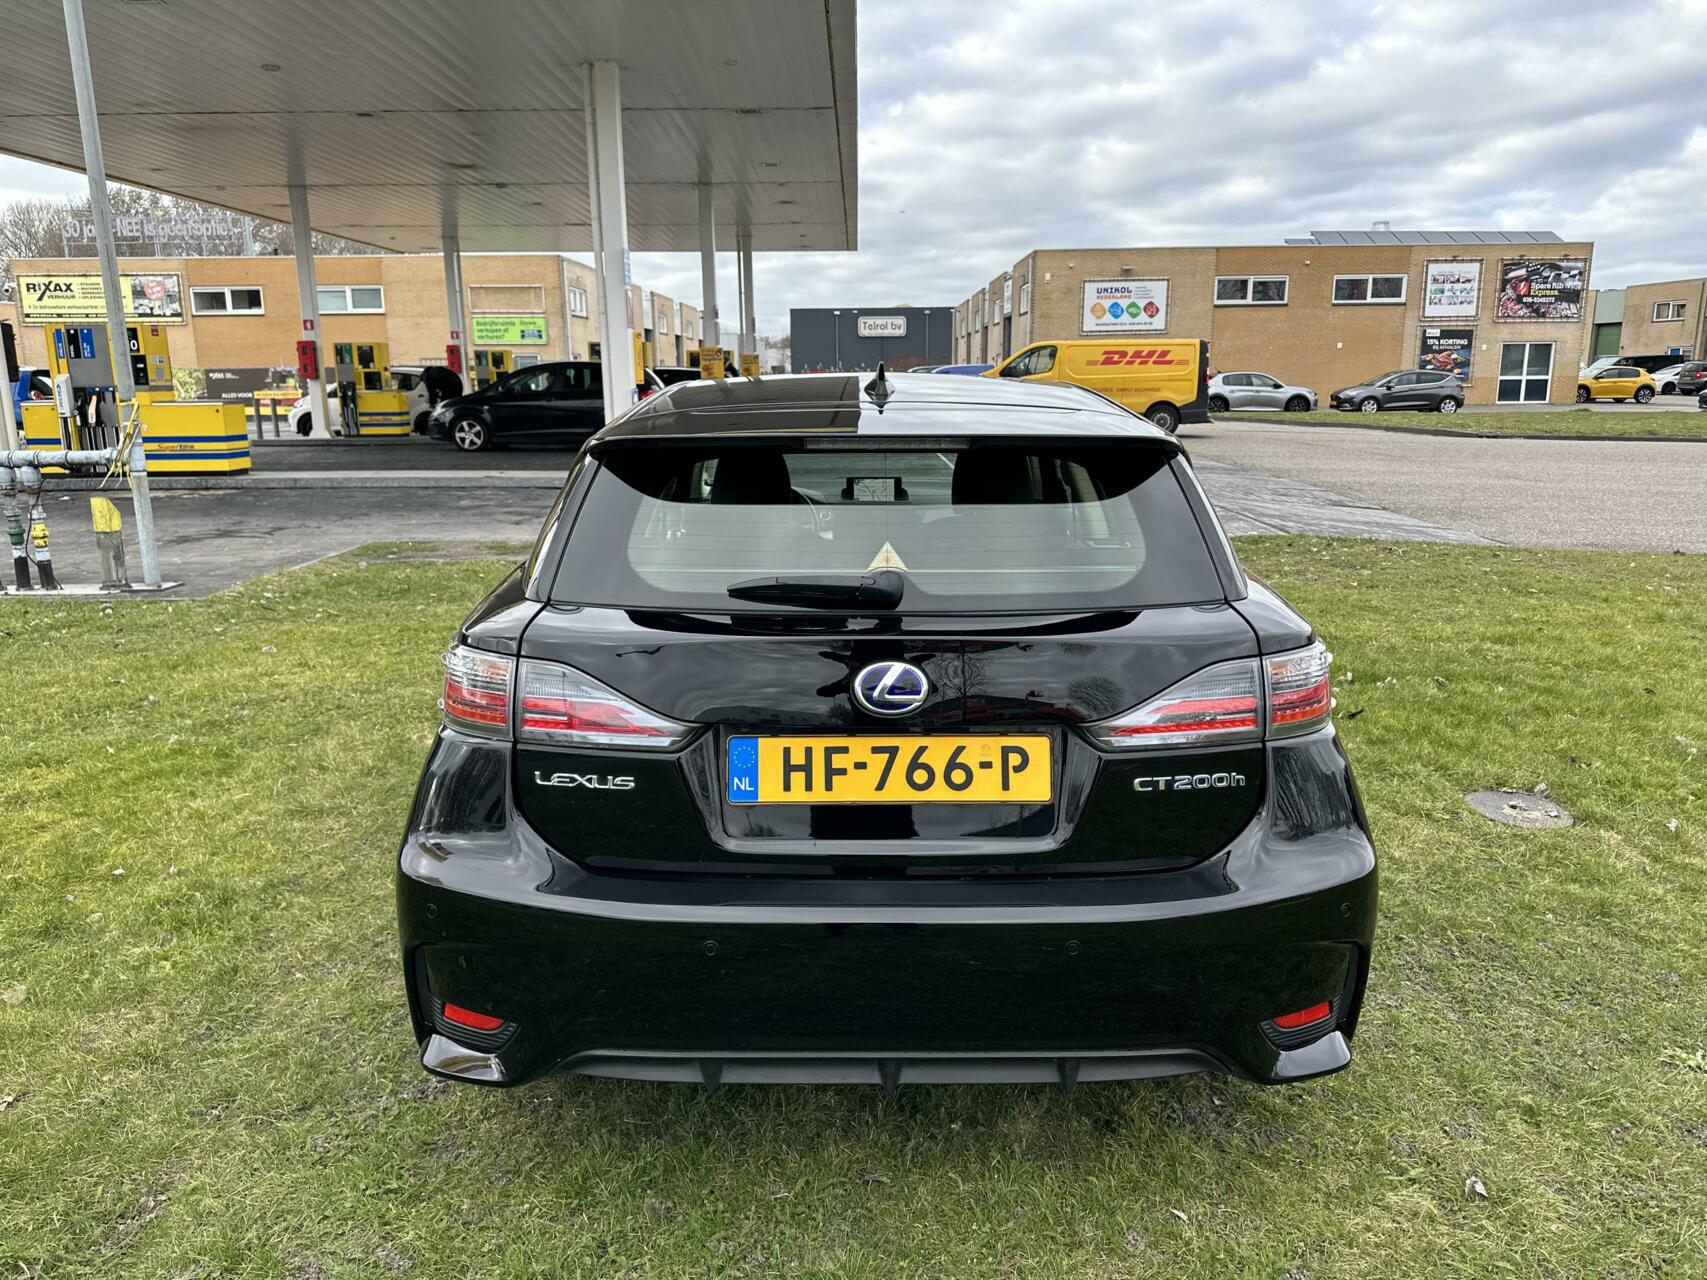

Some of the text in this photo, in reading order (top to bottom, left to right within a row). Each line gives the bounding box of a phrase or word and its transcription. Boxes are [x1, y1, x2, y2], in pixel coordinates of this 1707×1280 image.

[26, 281, 74, 301] RIXAX
[1096, 286, 1132, 294] UNIKOL
[1530, 282, 1552, 290] Spare
[862, 321, 902, 330] Telrol bv
[1100, 349, 1176, 366] DHL
[733, 745, 1030, 792] NL HF-766-P
[534, 771, 635, 789] LEXUS
